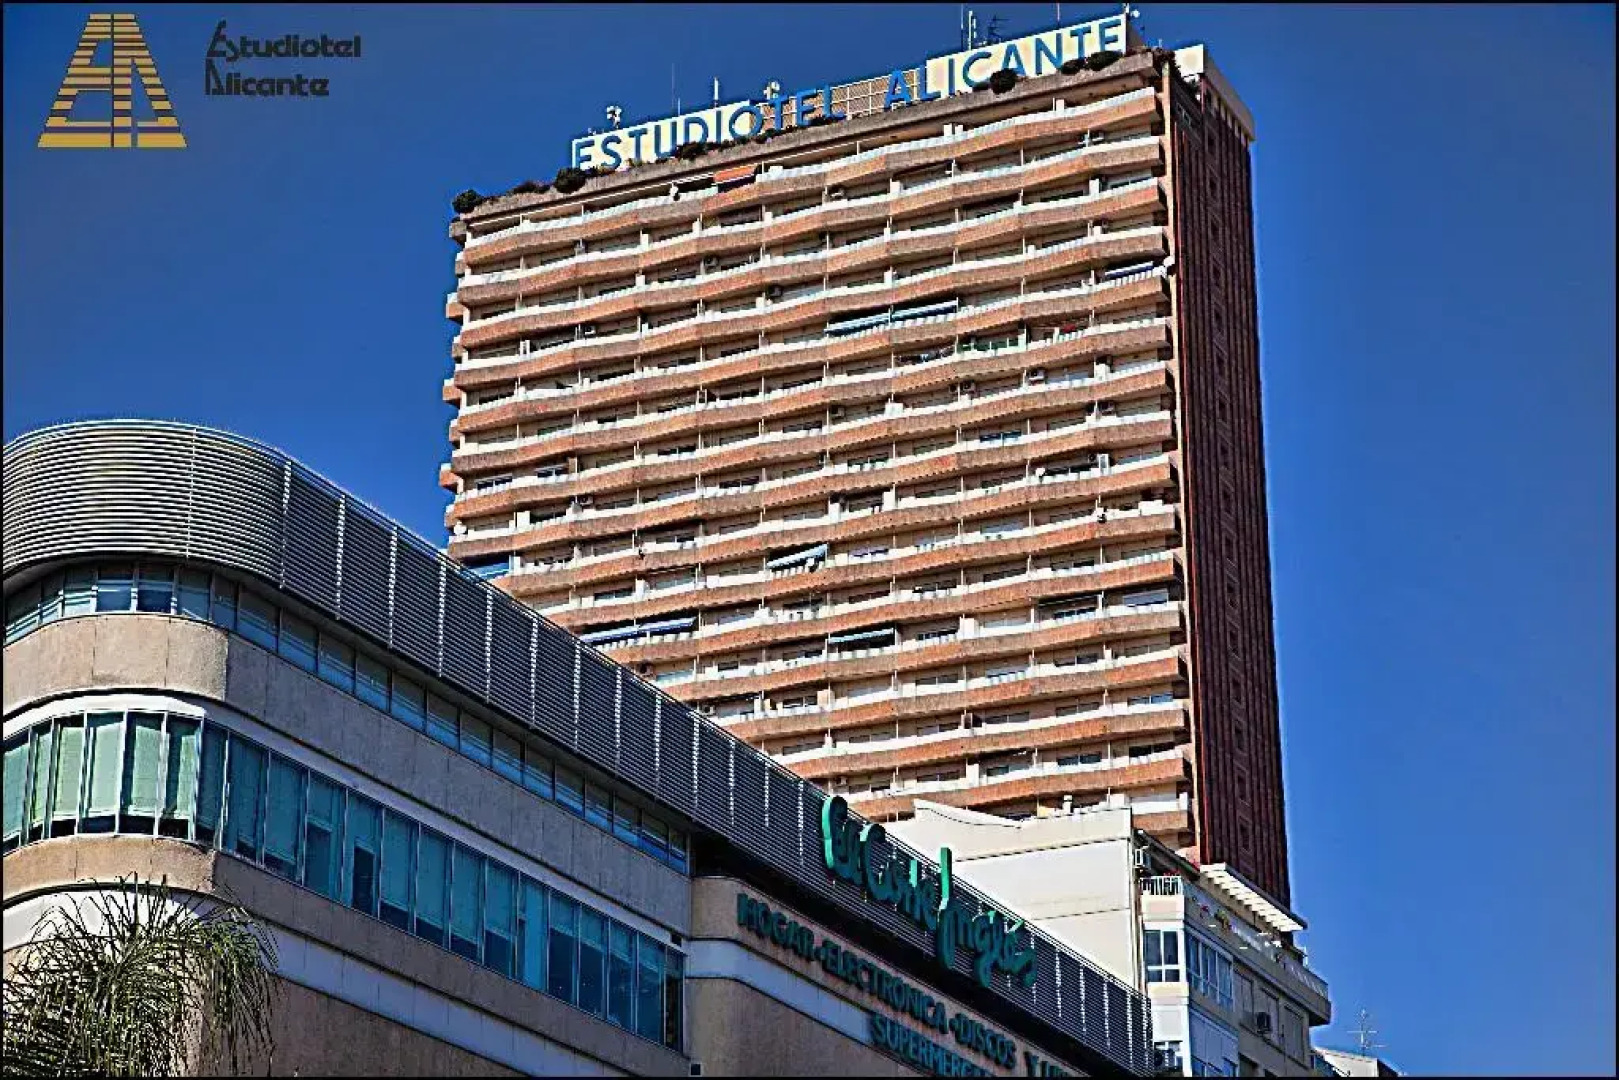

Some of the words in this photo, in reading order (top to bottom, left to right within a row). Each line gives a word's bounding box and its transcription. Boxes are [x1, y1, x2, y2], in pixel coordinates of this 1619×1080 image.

[574, 84, 845, 170] ESTUDIOTEL
[884, 19, 1122, 109] ALICANTE
[737, 893, 815, 961] HOGAR
